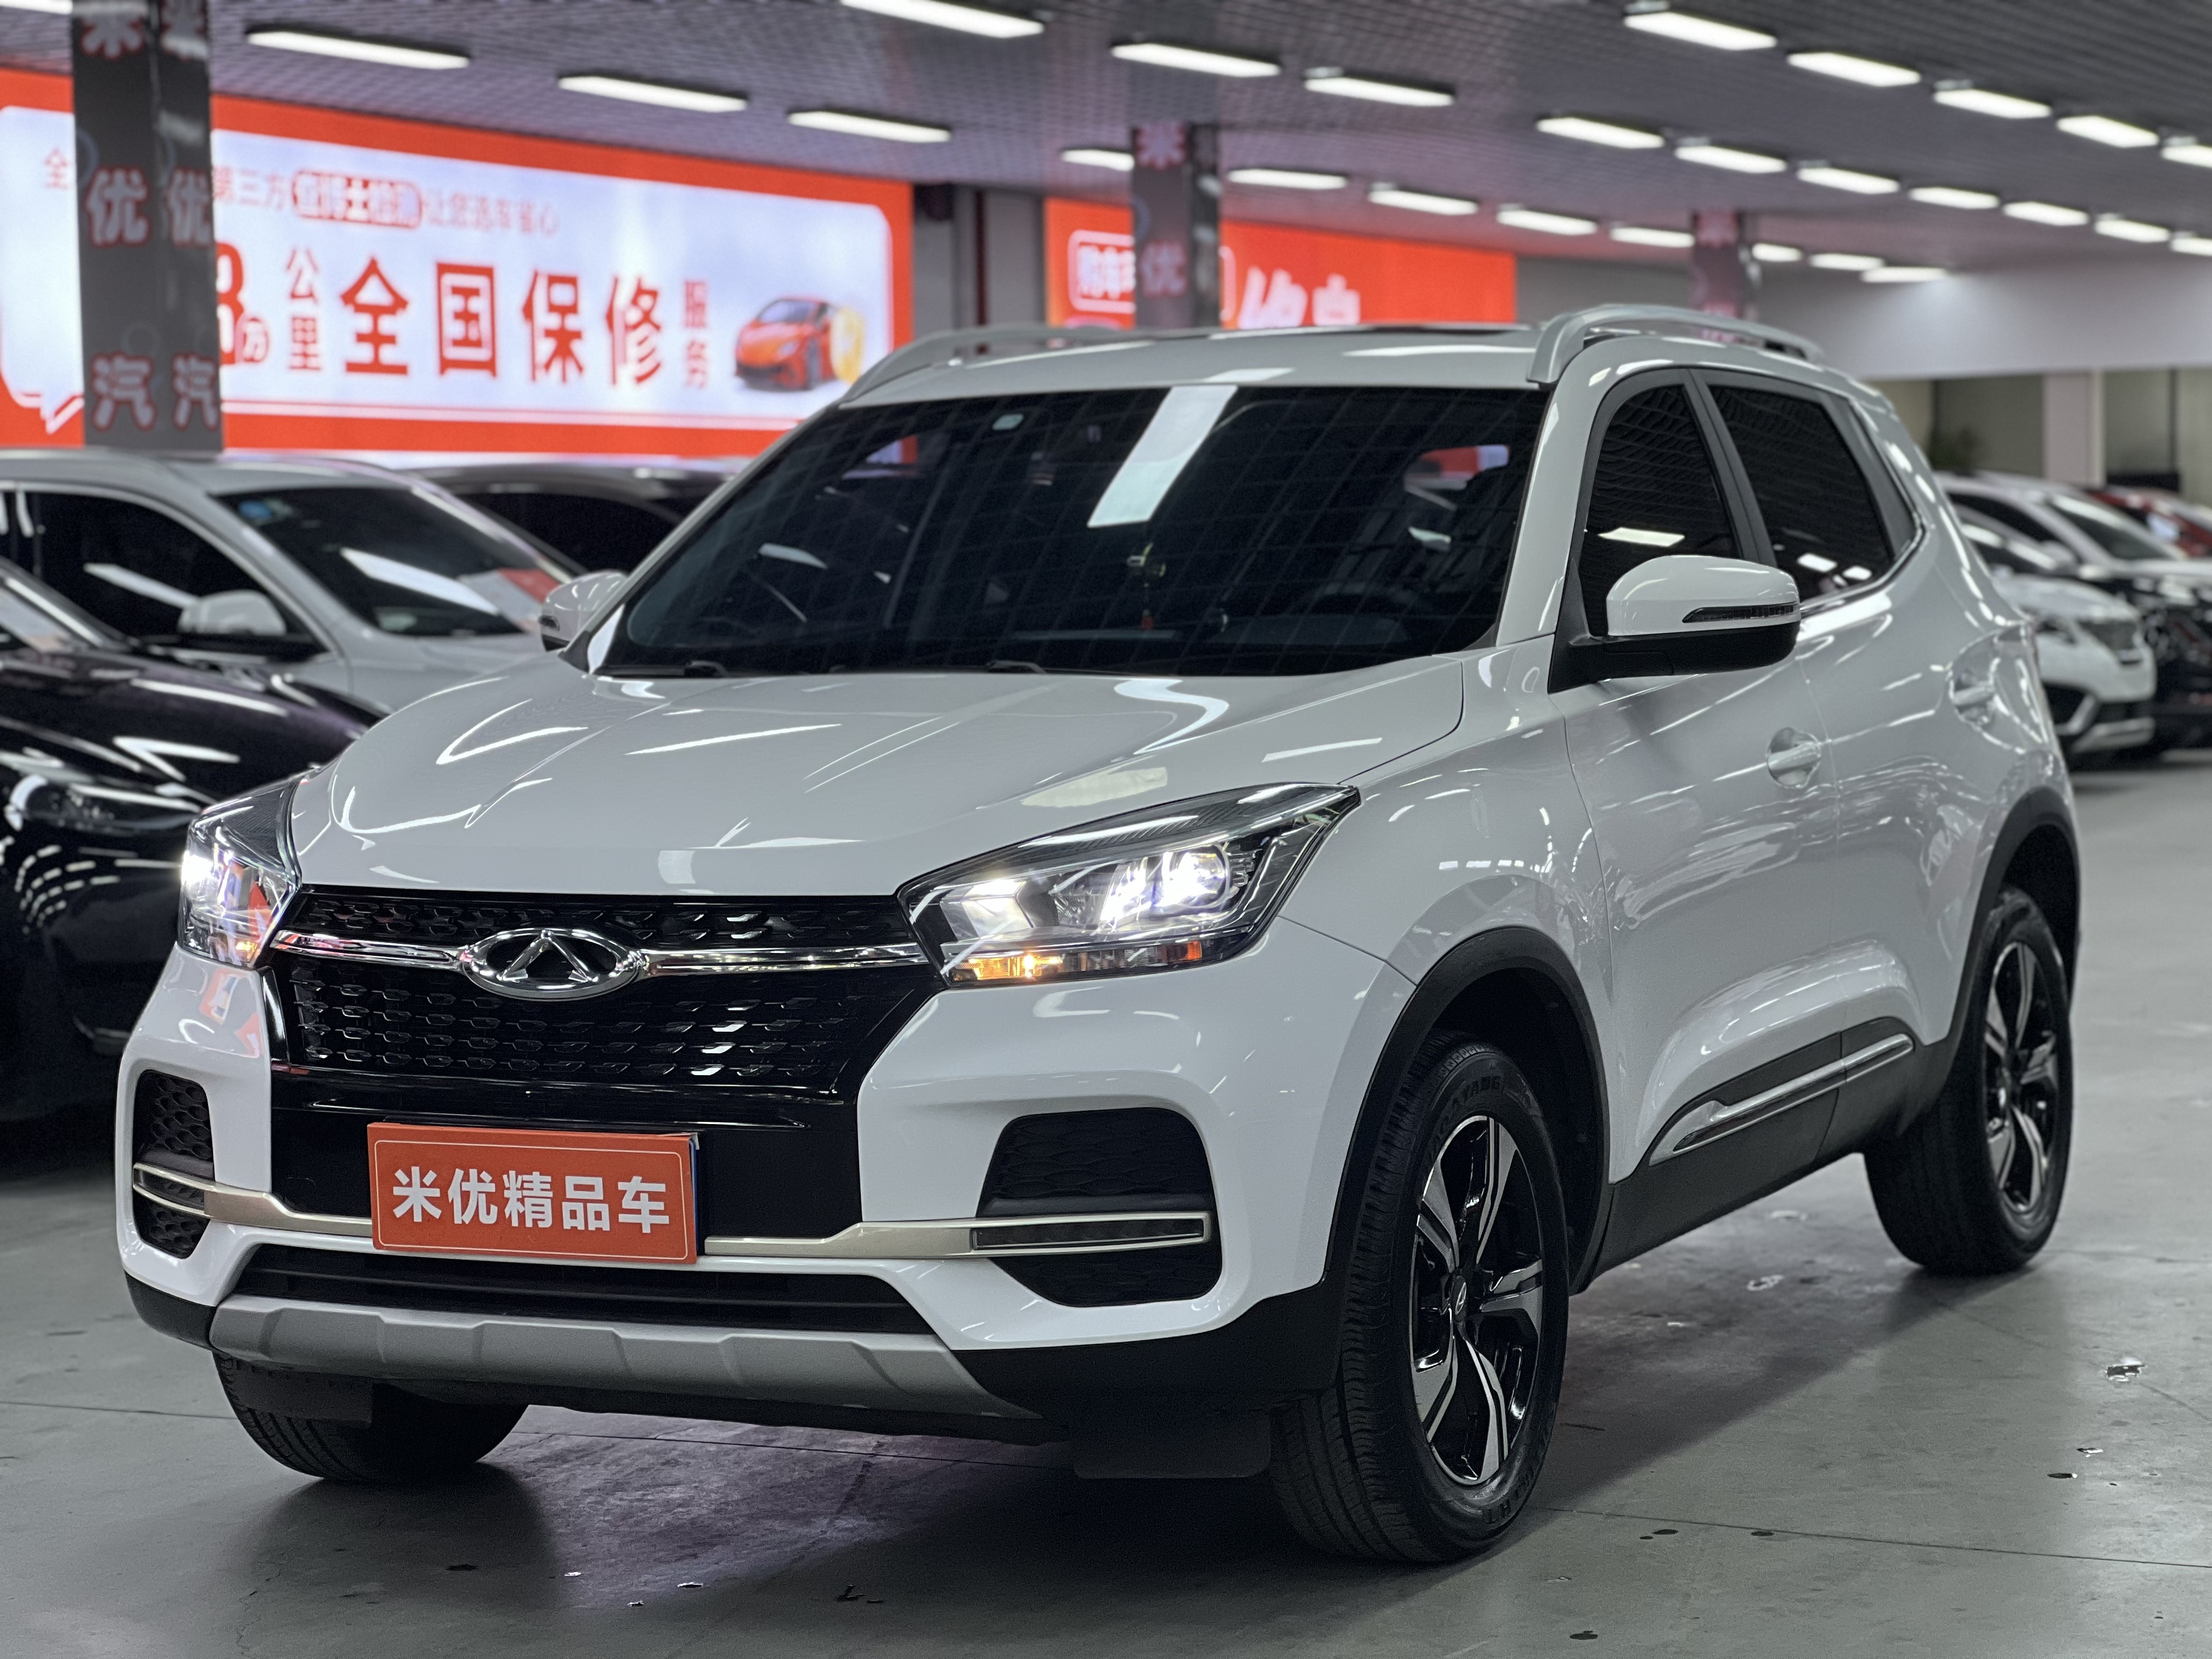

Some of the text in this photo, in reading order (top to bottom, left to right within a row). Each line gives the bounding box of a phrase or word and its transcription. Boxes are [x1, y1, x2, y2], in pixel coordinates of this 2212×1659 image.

[285, 247, 323, 371] 公里
[339, 255, 663, 386] 全国保修
[392, 1165, 670, 1234] 米优精品车
